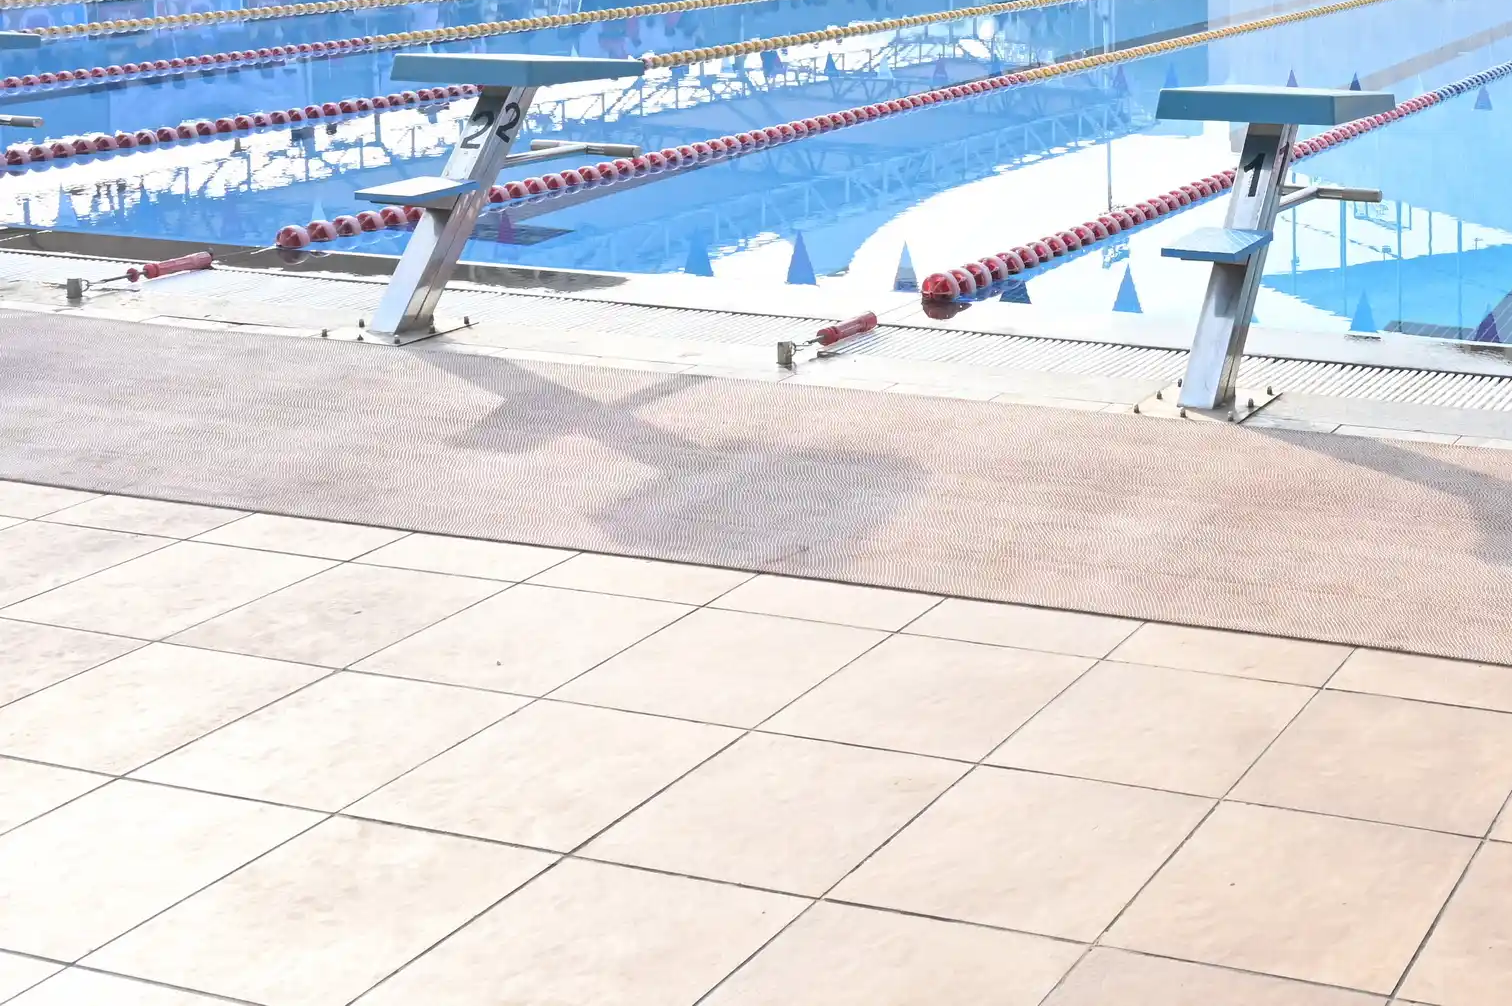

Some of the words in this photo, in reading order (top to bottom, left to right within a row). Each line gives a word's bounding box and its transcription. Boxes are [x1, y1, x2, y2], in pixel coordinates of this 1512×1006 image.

[460, 110, 495, 150] 2
[496, 101, 521, 143] 2
[1243, 153, 1266, 198] 1
